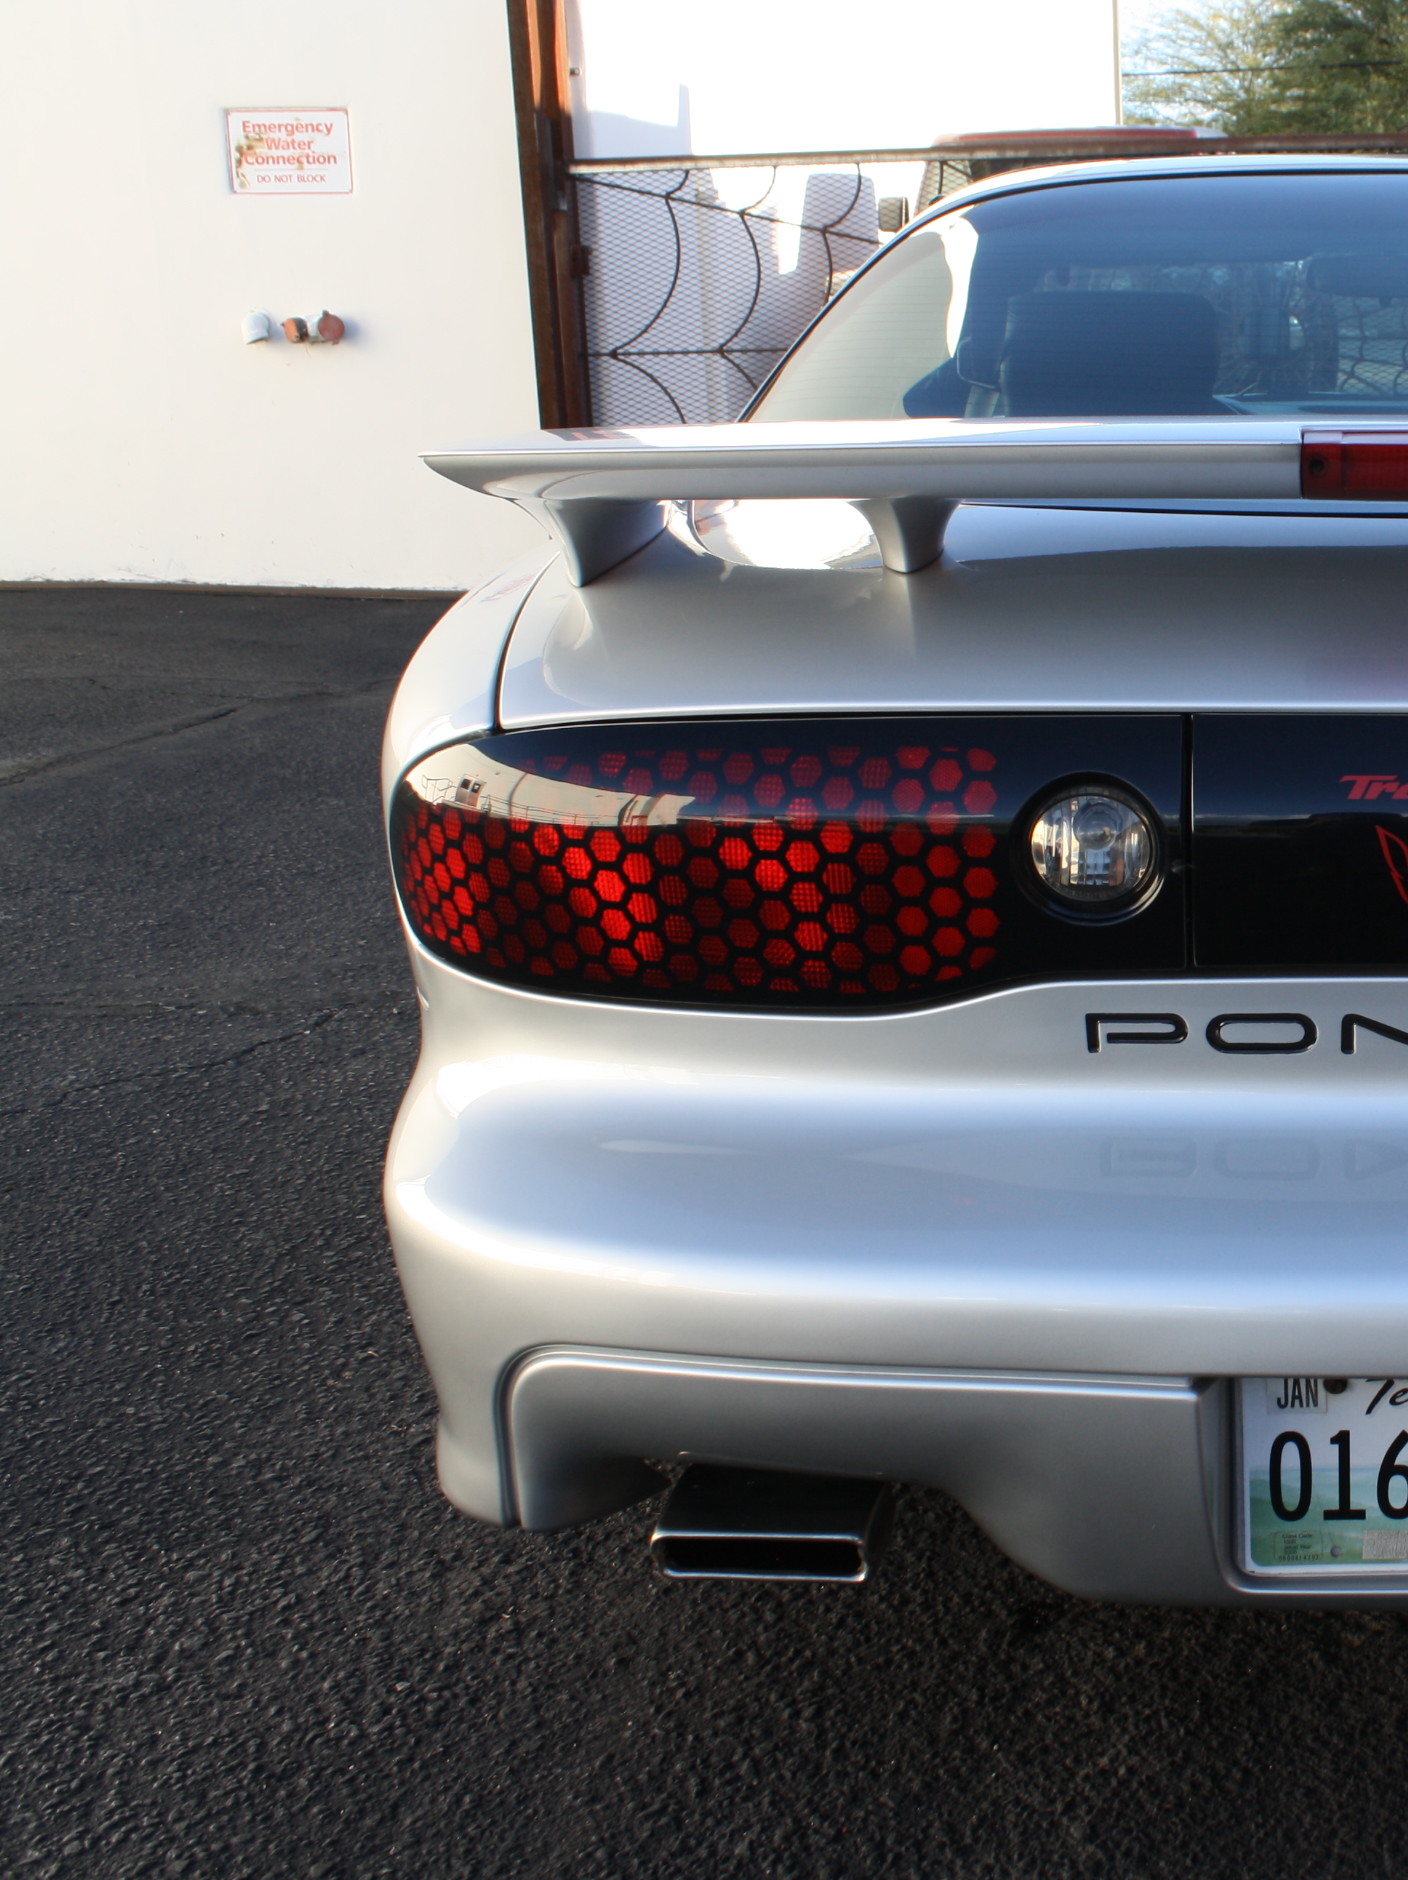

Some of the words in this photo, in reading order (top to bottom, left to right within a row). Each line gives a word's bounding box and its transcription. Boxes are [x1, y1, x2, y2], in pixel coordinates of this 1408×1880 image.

[242, 120, 333, 136] Emergency
[264, 137, 314, 150] Water
[243, 152, 337, 165] Connection
[257, 174, 271, 183] DO
[274, 174, 293, 183] NOT
[297, 174, 326, 183] BLOCK
[1277, 1377, 1319, 1409] JAN
